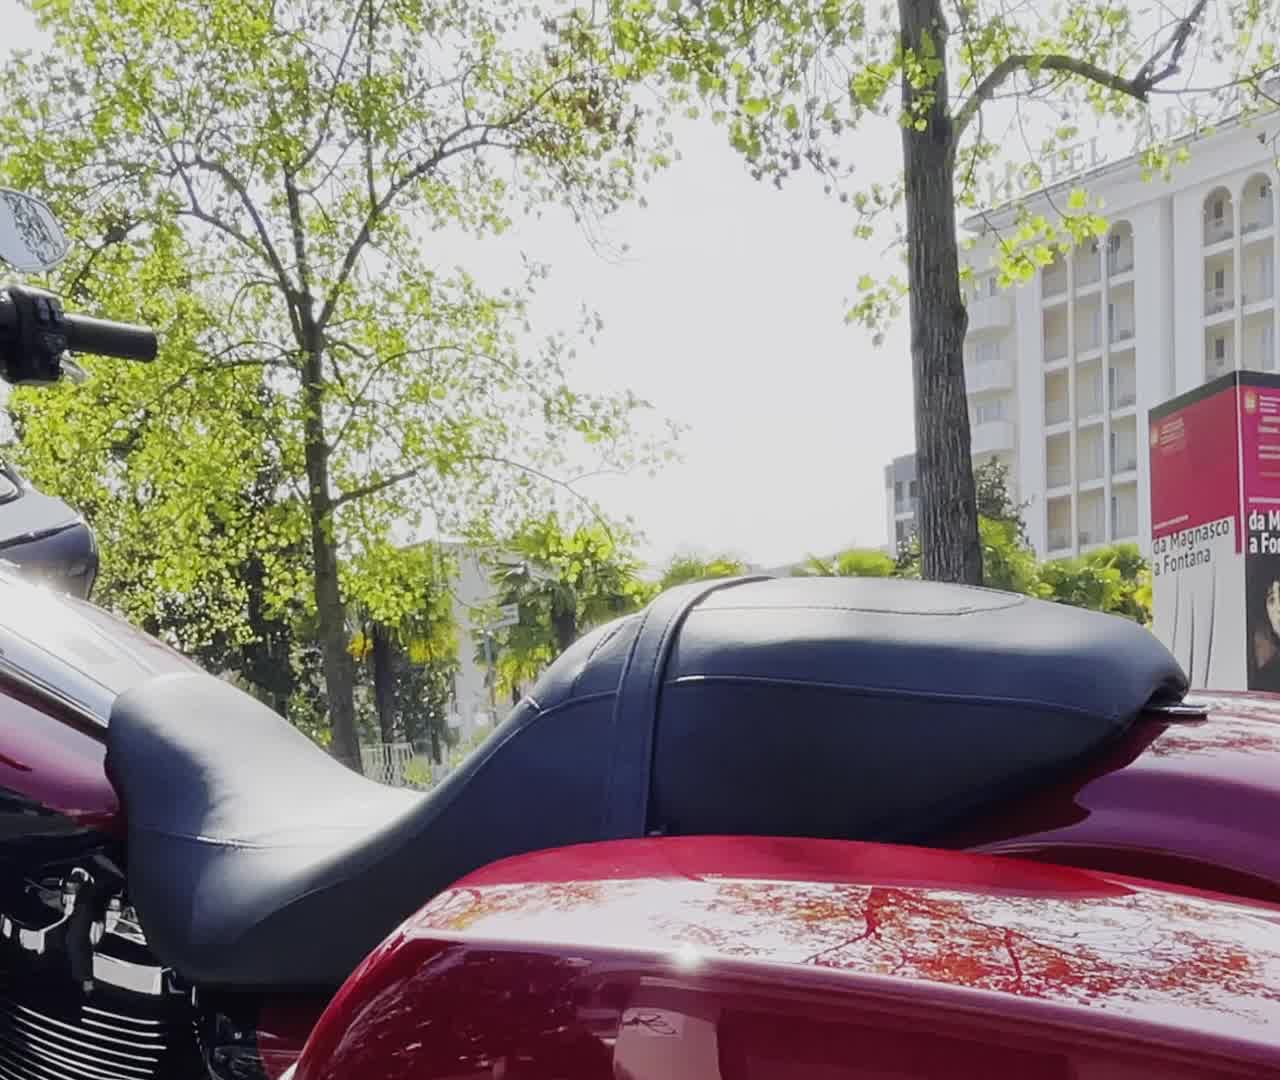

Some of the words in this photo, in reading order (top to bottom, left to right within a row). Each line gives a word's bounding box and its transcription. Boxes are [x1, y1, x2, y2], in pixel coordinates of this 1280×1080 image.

[1249, 509, 1265, 531] da
[1153, 536, 1166, 554] da
[1170, 519, 1229, 550] Magnasco
[1249, 537, 1258, 553] a
[1154, 562, 1161, 576] a
[1163, 548, 1211, 574] Fontana
